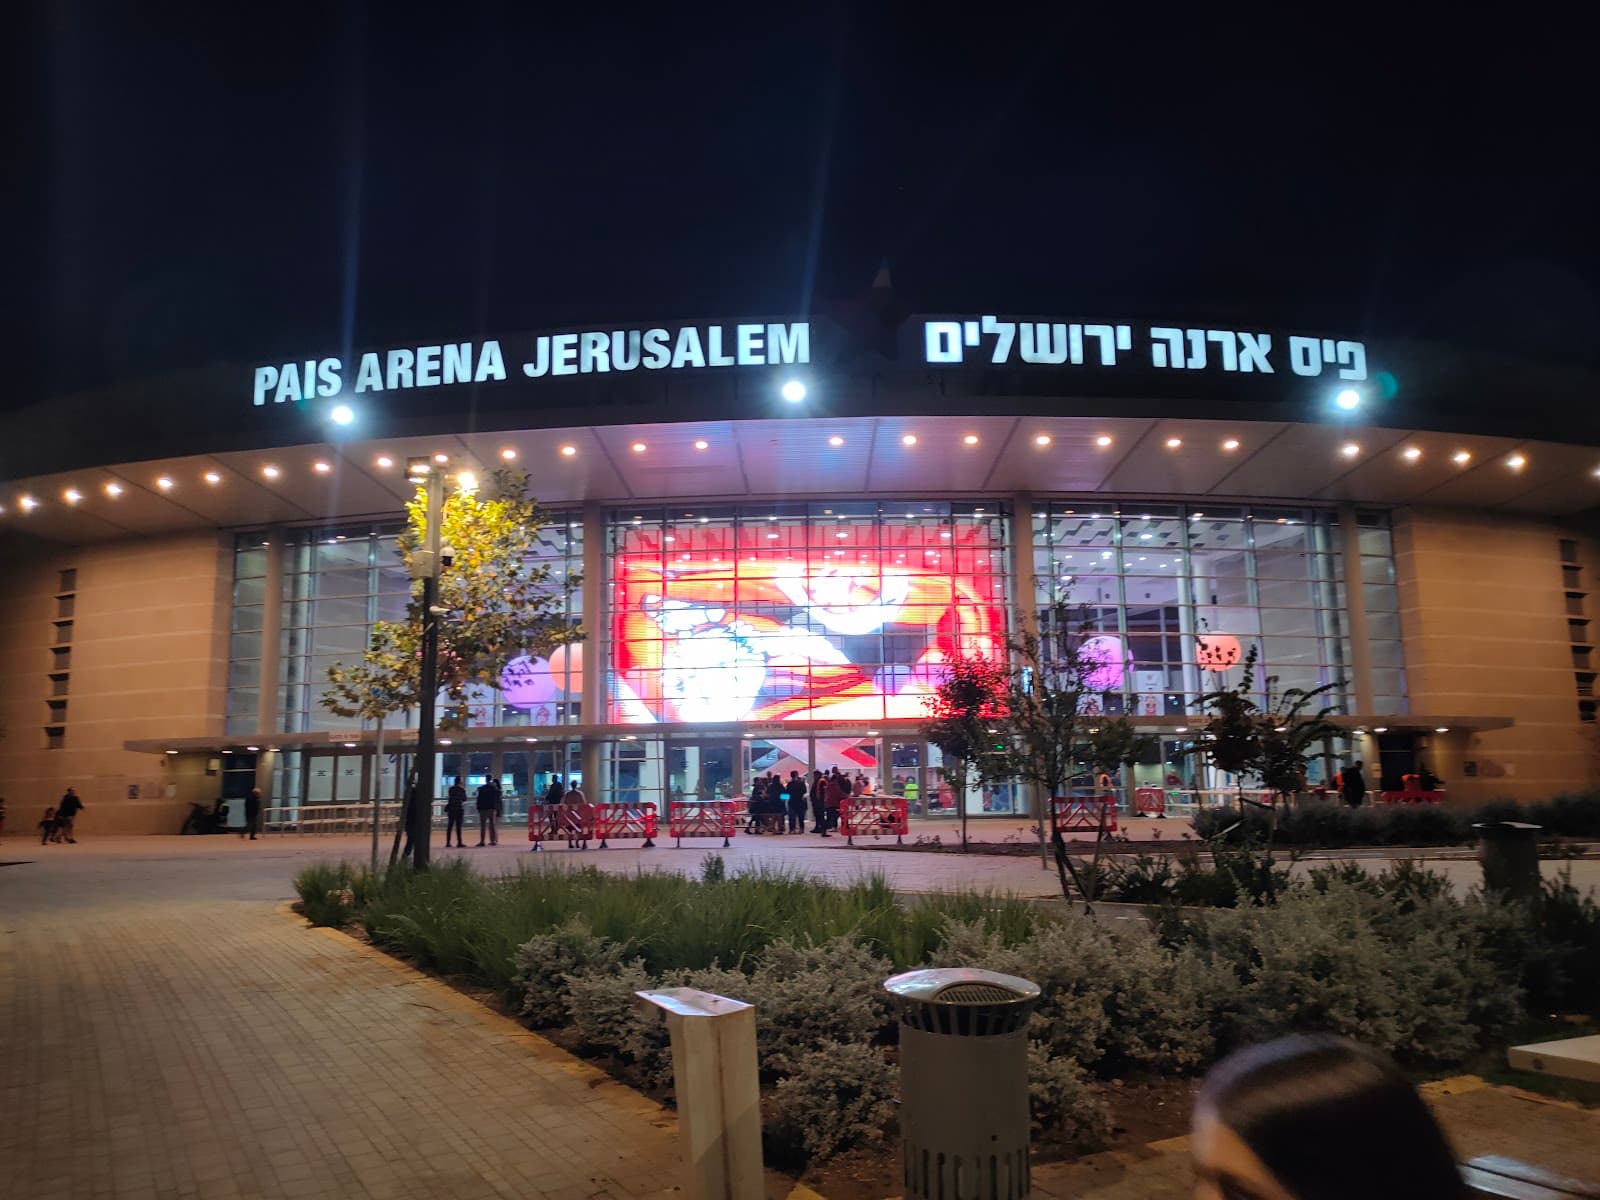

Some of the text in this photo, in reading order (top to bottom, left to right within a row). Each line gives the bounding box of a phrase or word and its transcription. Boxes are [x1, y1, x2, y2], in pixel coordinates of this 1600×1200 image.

[253, 322, 810, 405] PAIS ARENA JERUSALEM
[925, 315, 1367, 380] פיס ארנה ירושלים
